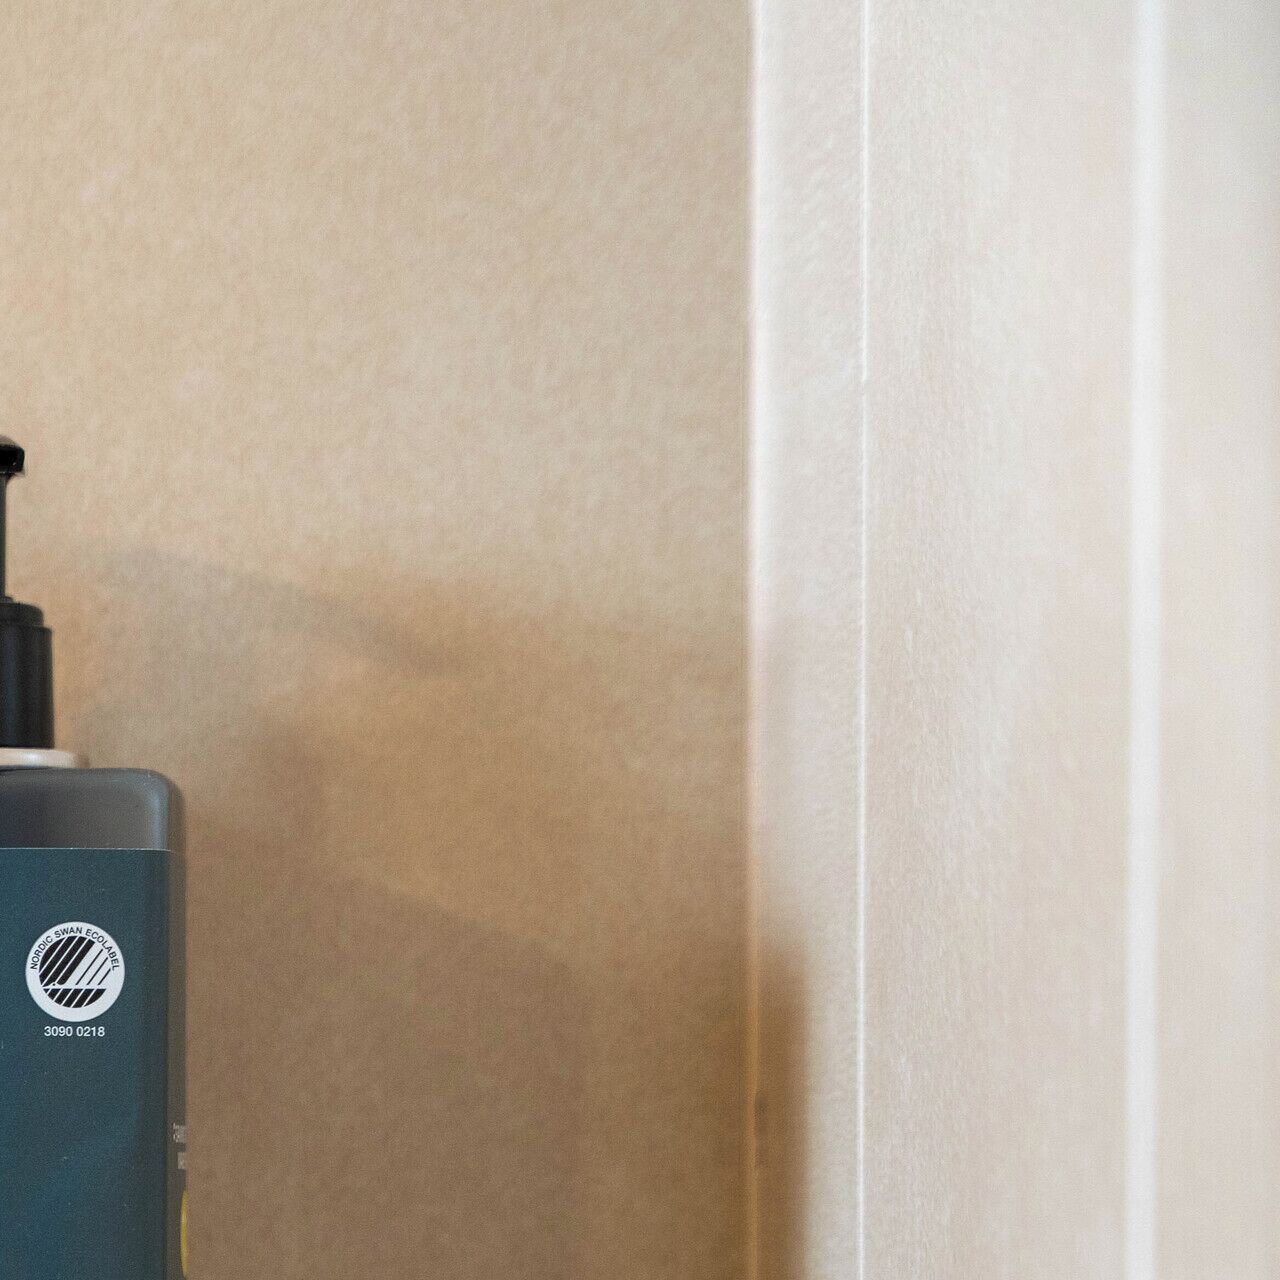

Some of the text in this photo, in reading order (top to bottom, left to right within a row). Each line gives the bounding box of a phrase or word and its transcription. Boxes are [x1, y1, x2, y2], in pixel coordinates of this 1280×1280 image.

[30, 927, 120, 971] NORDIC SWAN ECOLABEL
[44, 1026, 105, 1037] 3090 0218
